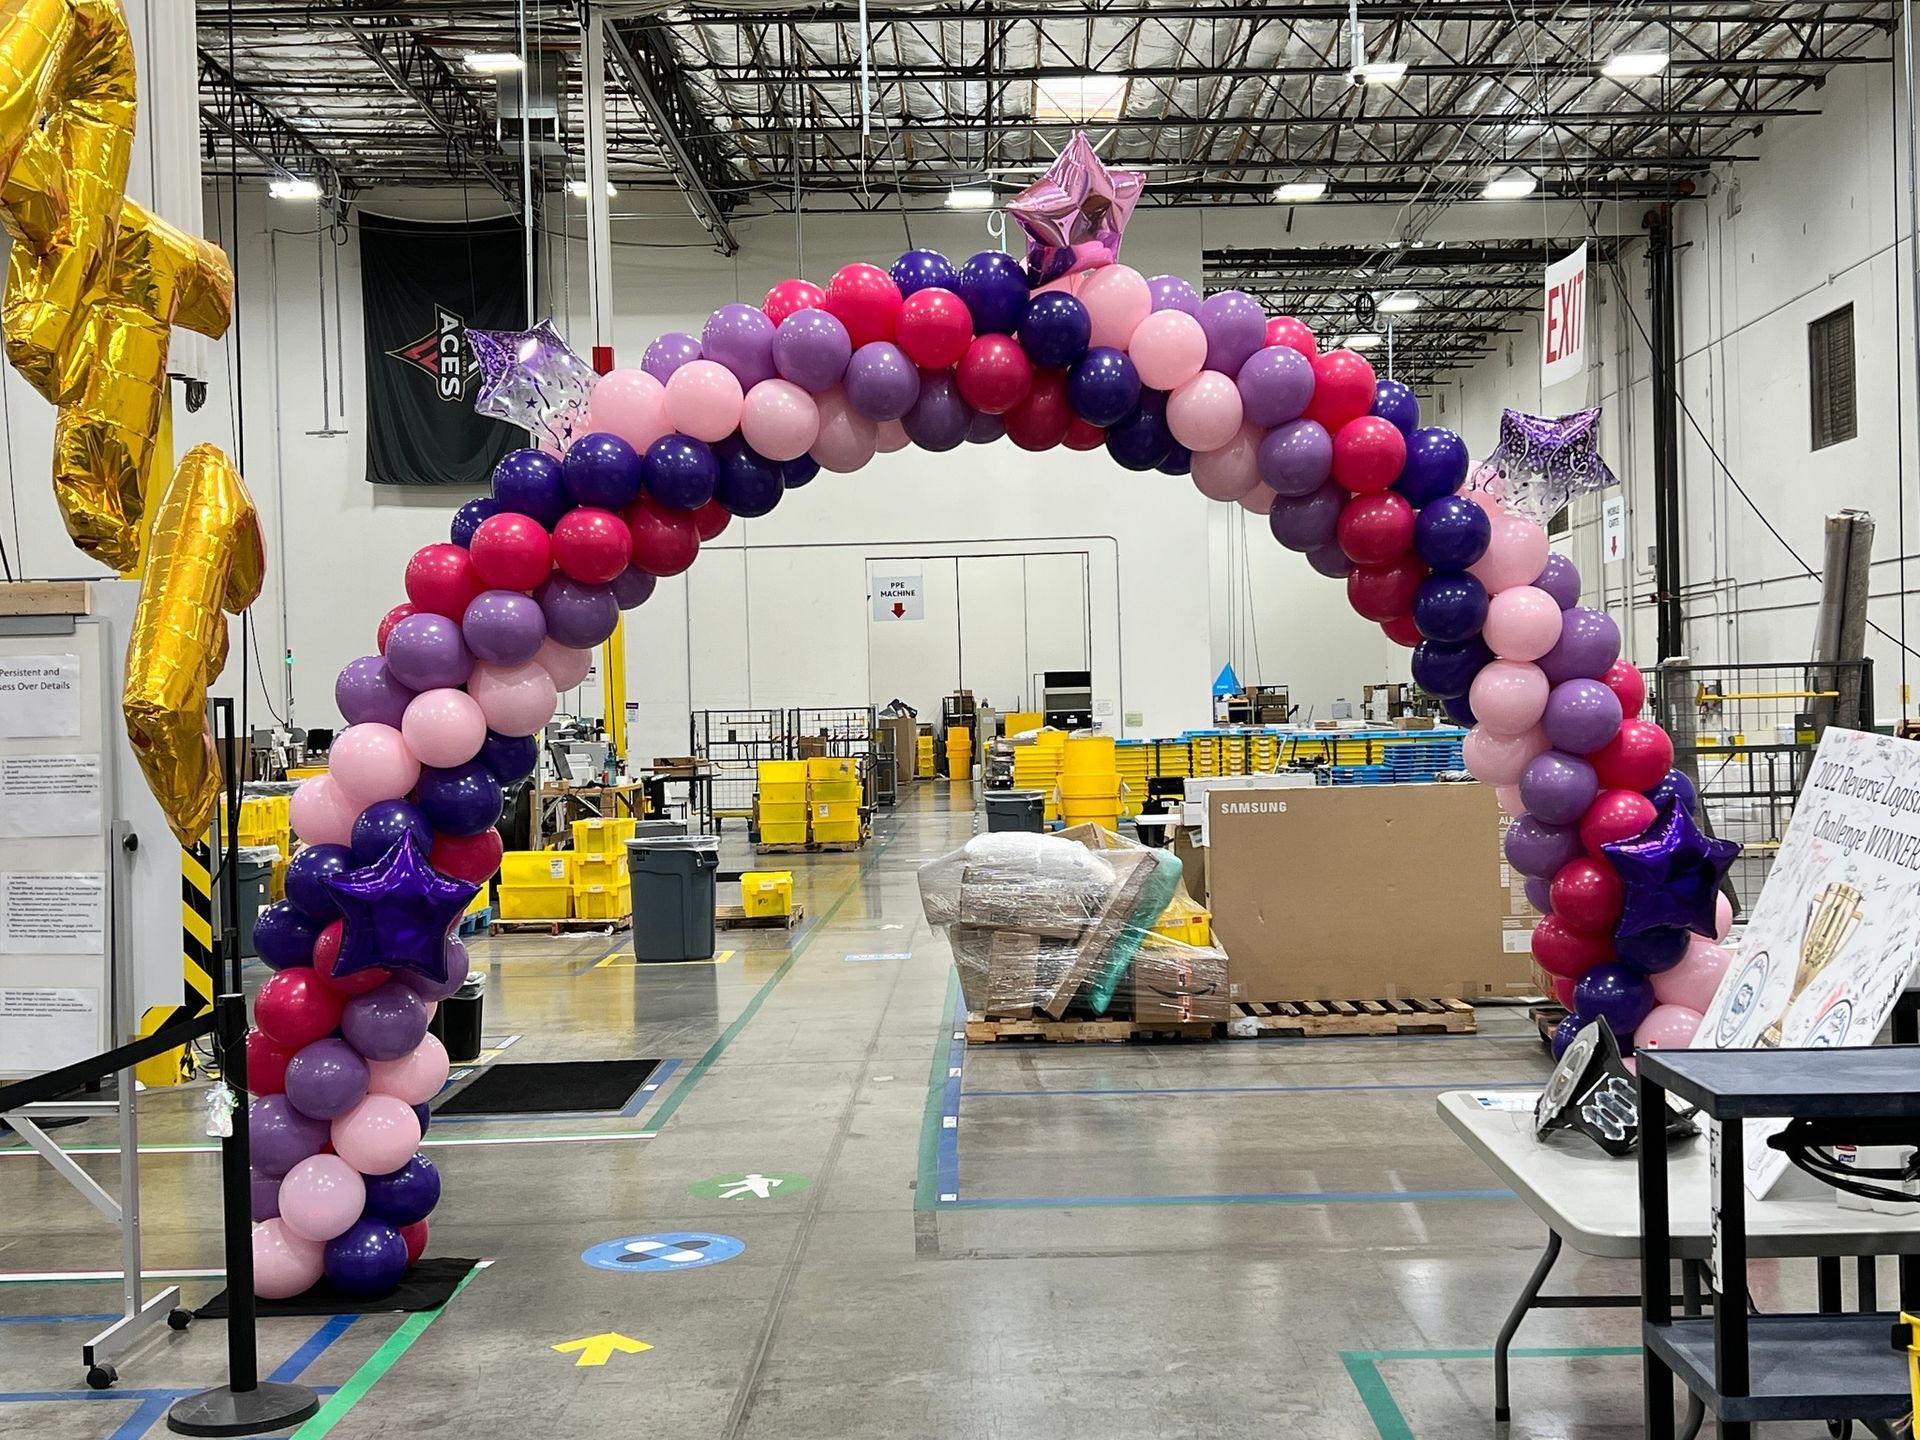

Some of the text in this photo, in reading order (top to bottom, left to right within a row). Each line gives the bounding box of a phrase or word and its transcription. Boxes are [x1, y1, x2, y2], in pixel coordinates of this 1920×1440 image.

[1546, 269, 1584, 364] EXIT
[440, 312, 460, 396] ACES
[0, 667, 60, 677] Persistent and
[17, 682, 38, 691] Over
[40, 681, 71, 690] Details
[1221, 801, 1287, 814] SAMSUNG
[1814, 761, 1920, 818] 2022 Reverse Logist
[1813, 809, 1867, 857] Challenge
